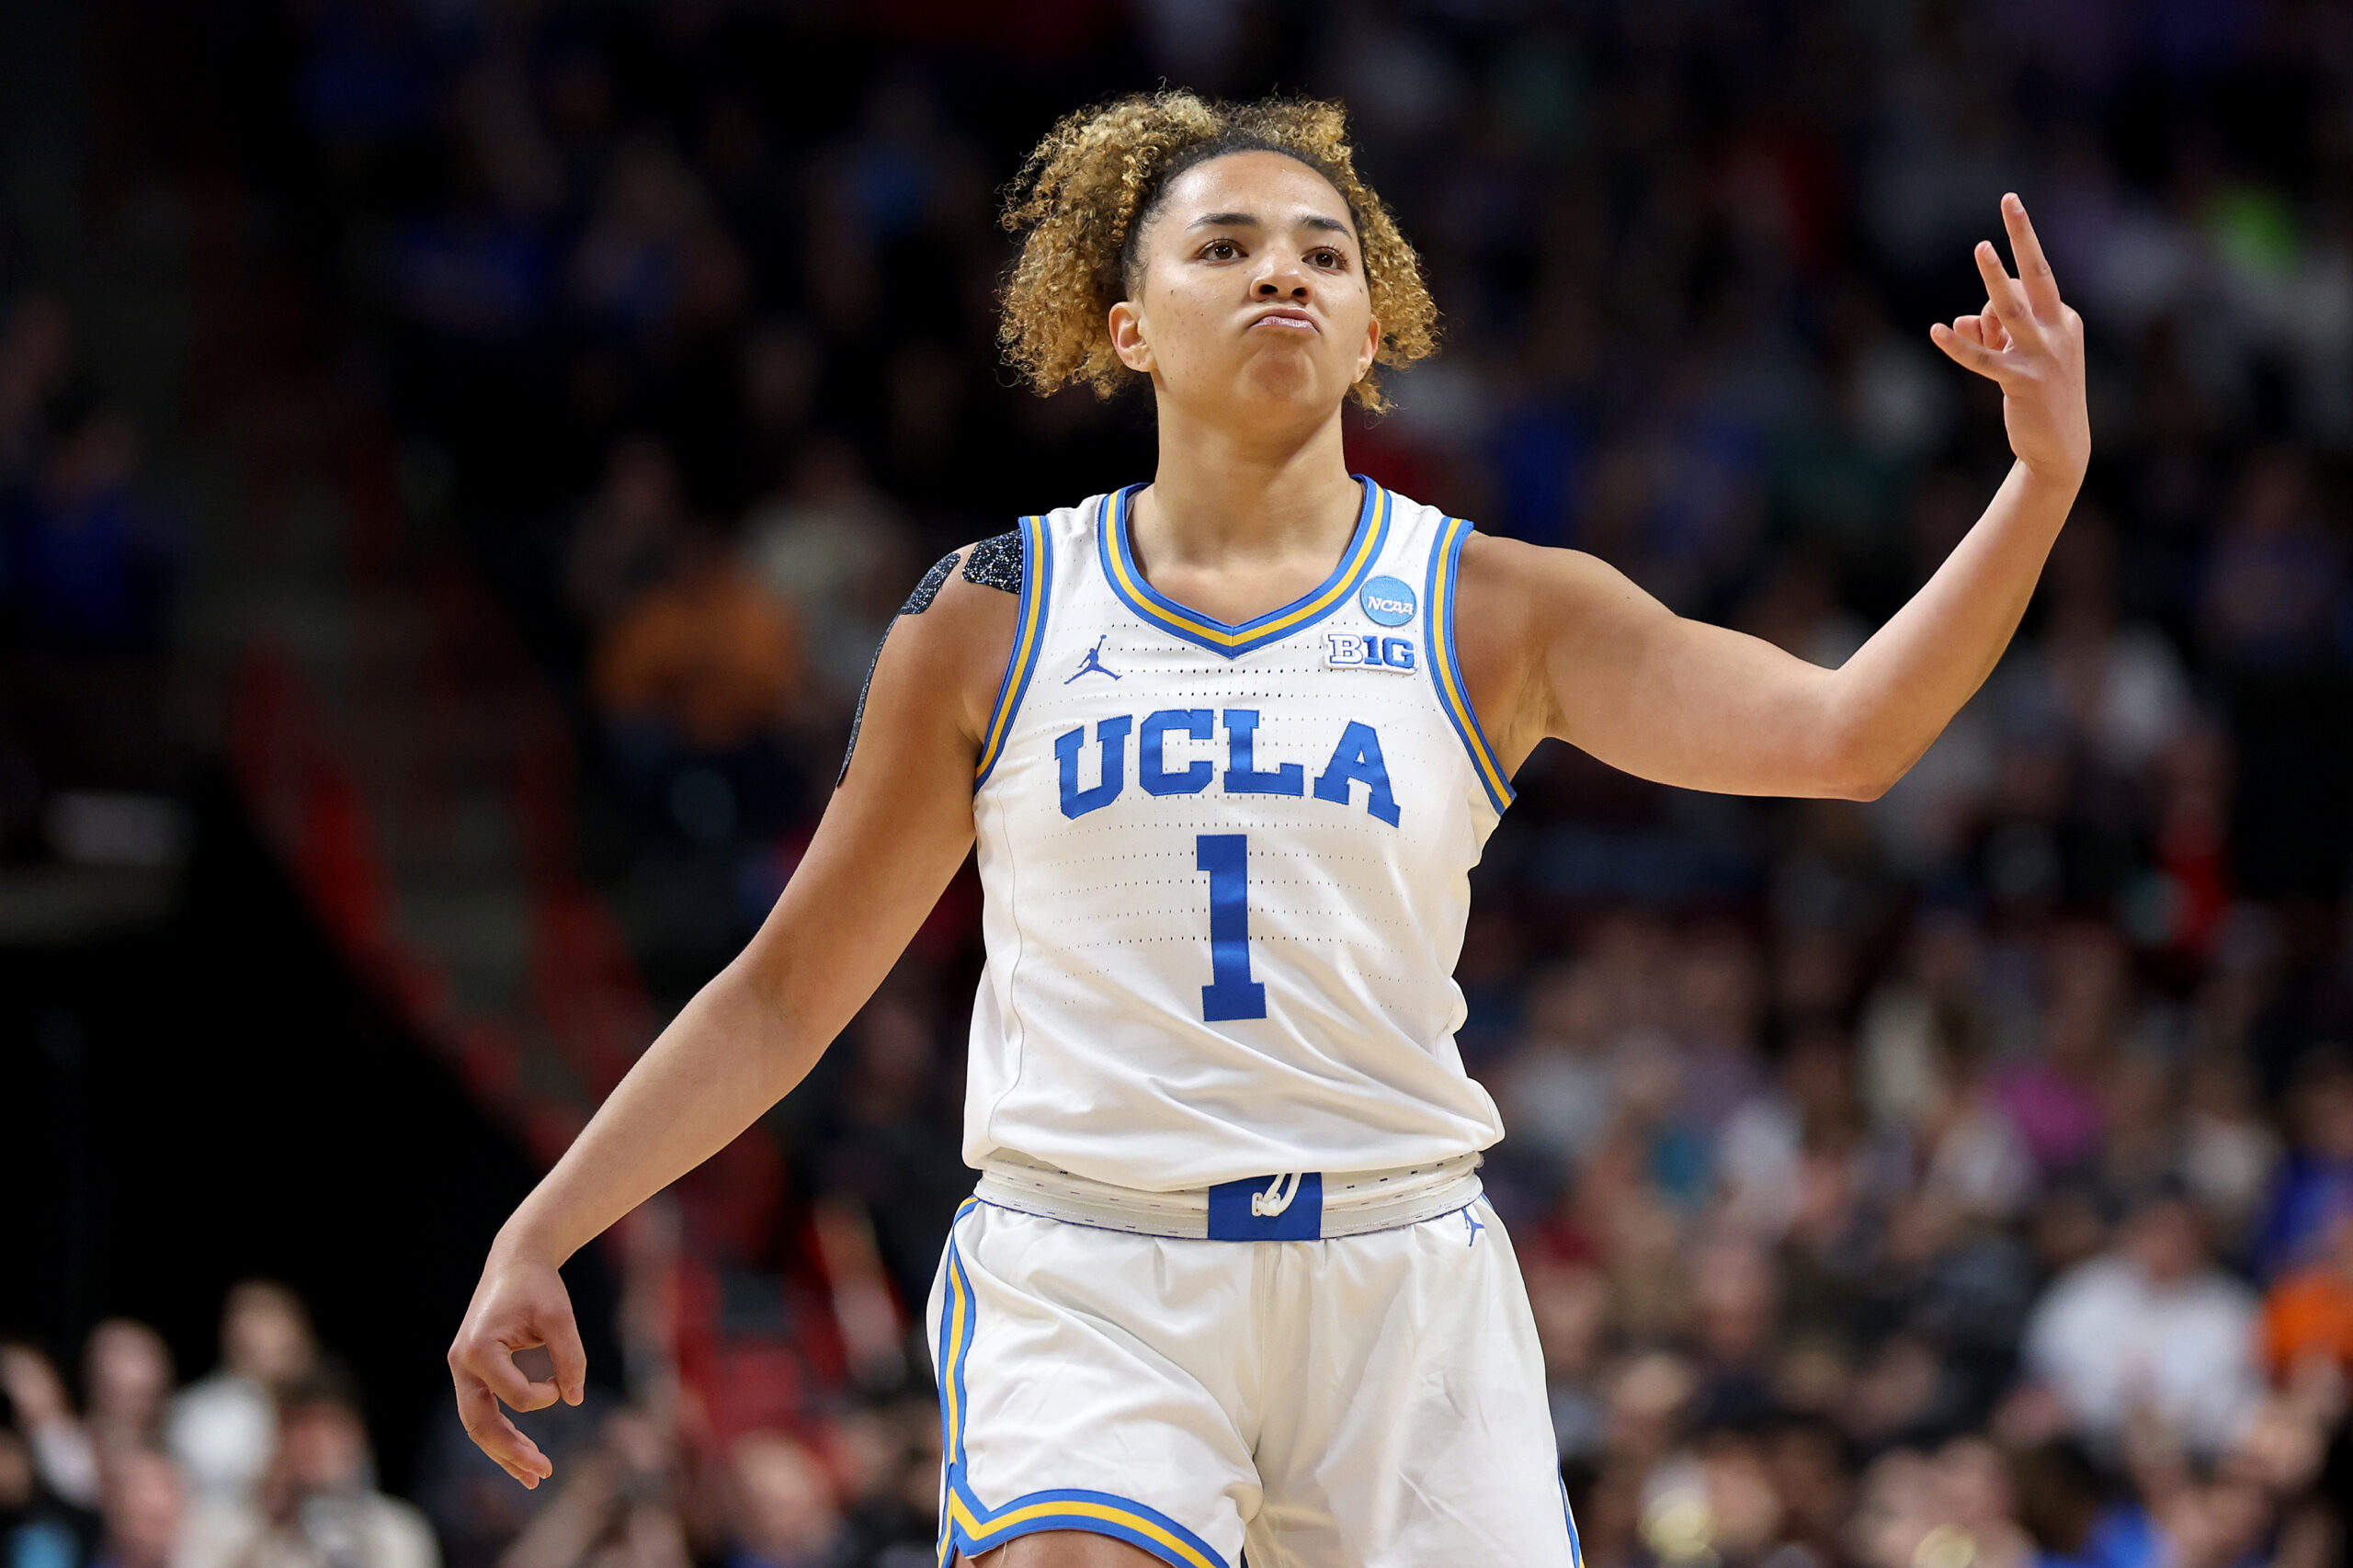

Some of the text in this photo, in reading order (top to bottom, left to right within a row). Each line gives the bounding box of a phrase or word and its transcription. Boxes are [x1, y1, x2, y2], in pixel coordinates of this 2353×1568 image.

[1368, 597, 1415, 615] NCAA
[1054, 709, 1401, 828] UCLA
[1196, 834, 1267, 1022] 1
